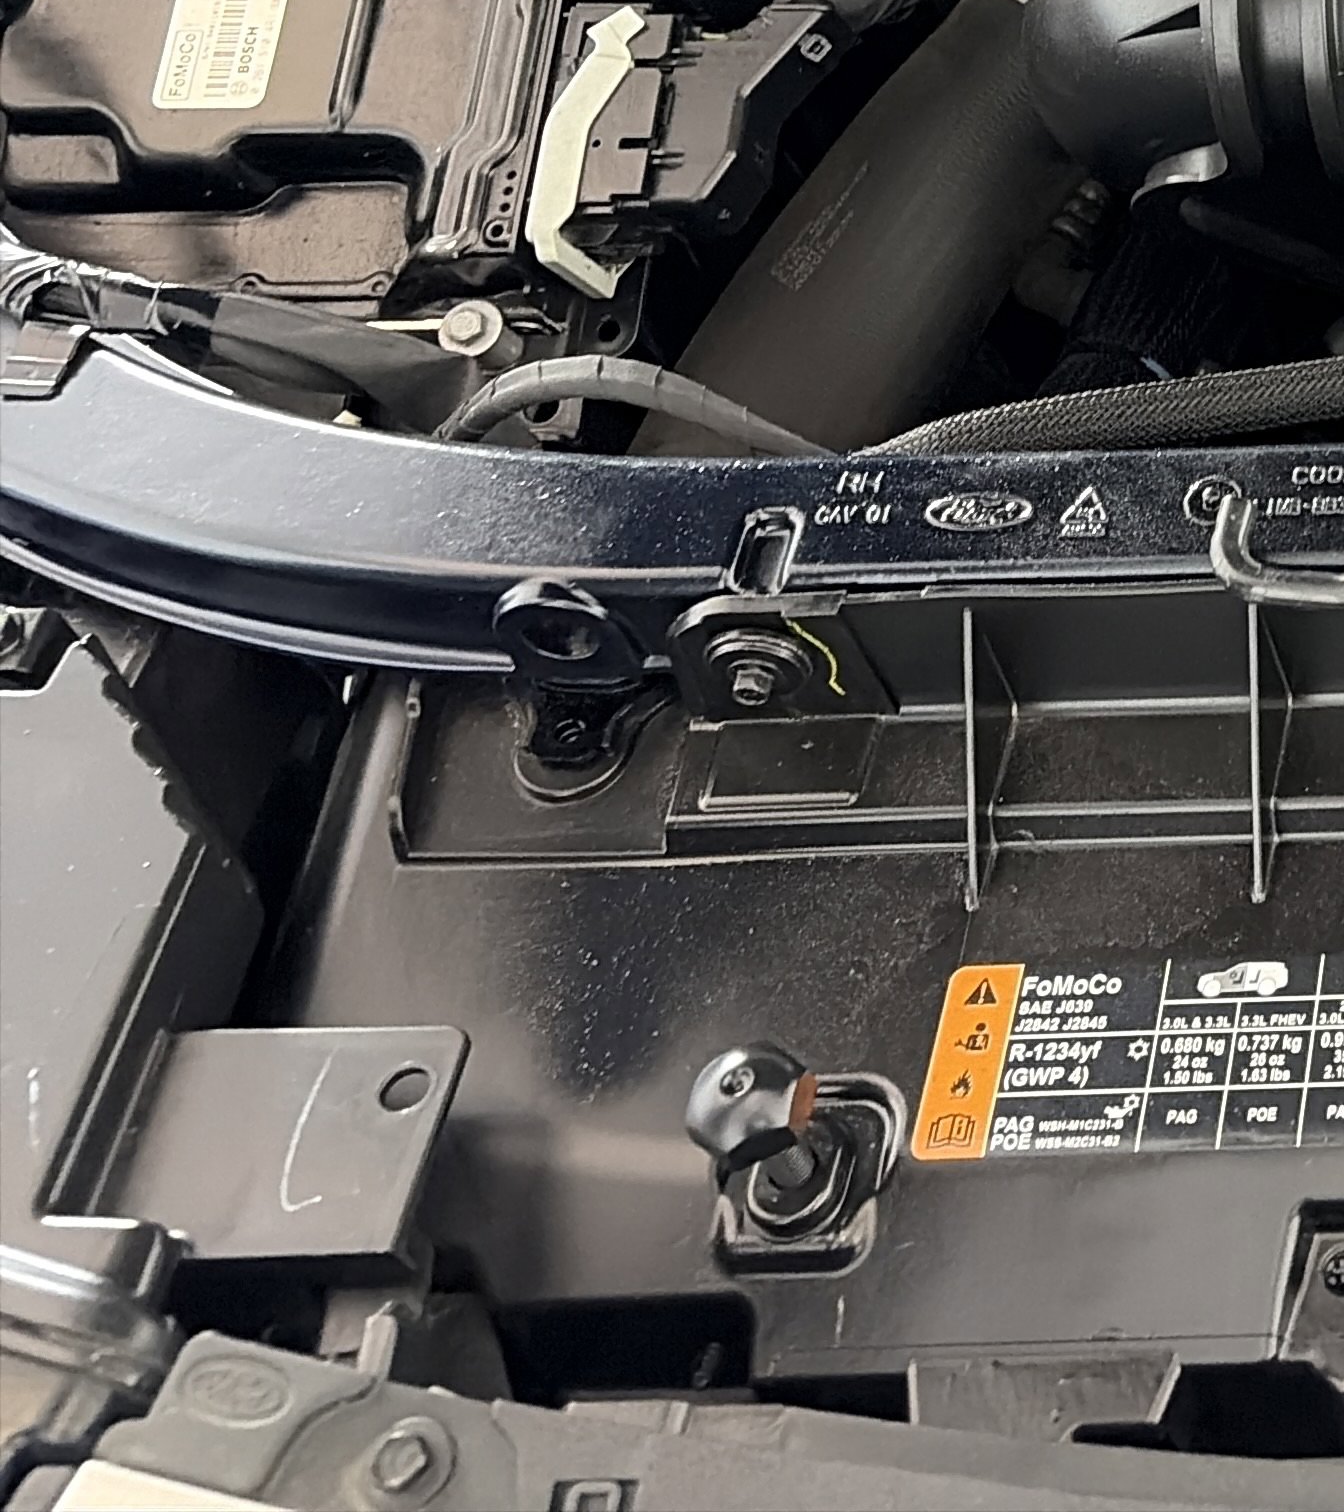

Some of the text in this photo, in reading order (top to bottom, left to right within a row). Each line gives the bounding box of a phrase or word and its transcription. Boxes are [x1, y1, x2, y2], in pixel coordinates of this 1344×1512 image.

[237, 26, 259, 74] BOSCH
[168, 33, 197, 97] FoMoCo
[836, 471, 885, 494] RH
[1021, 973, 1122, 997] FoMoCo
[1018, 1000, 1052, 1015] SAE
[1015, 1017, 1059, 1032] J2842
[1191, 1016, 1201, 1028] &
[1270, 1013, 1306, 1026] FHEV
[1009, 1040, 1102, 1063] R-1234yf
[1160, 1037, 1226, 1056] 0.680 kg
[1237, 1034, 1302, 1054] 0.737 kg
[1172, 1055, 1209, 1069] 24 oz
[1268, 1054, 1286, 1066] oz
[1004, 1066, 1089, 1090] (GWP 4)
[1163, 1070, 1213, 1085] 1.50 lbs
[1270, 1068, 1291, 1081] lbs
[1166, 1108, 1198, 1125] PAG
[1247, 1106, 1278, 1122] POE
[993, 1116, 1034, 1133] PAG
[990, 1133, 1032, 1150] POE
